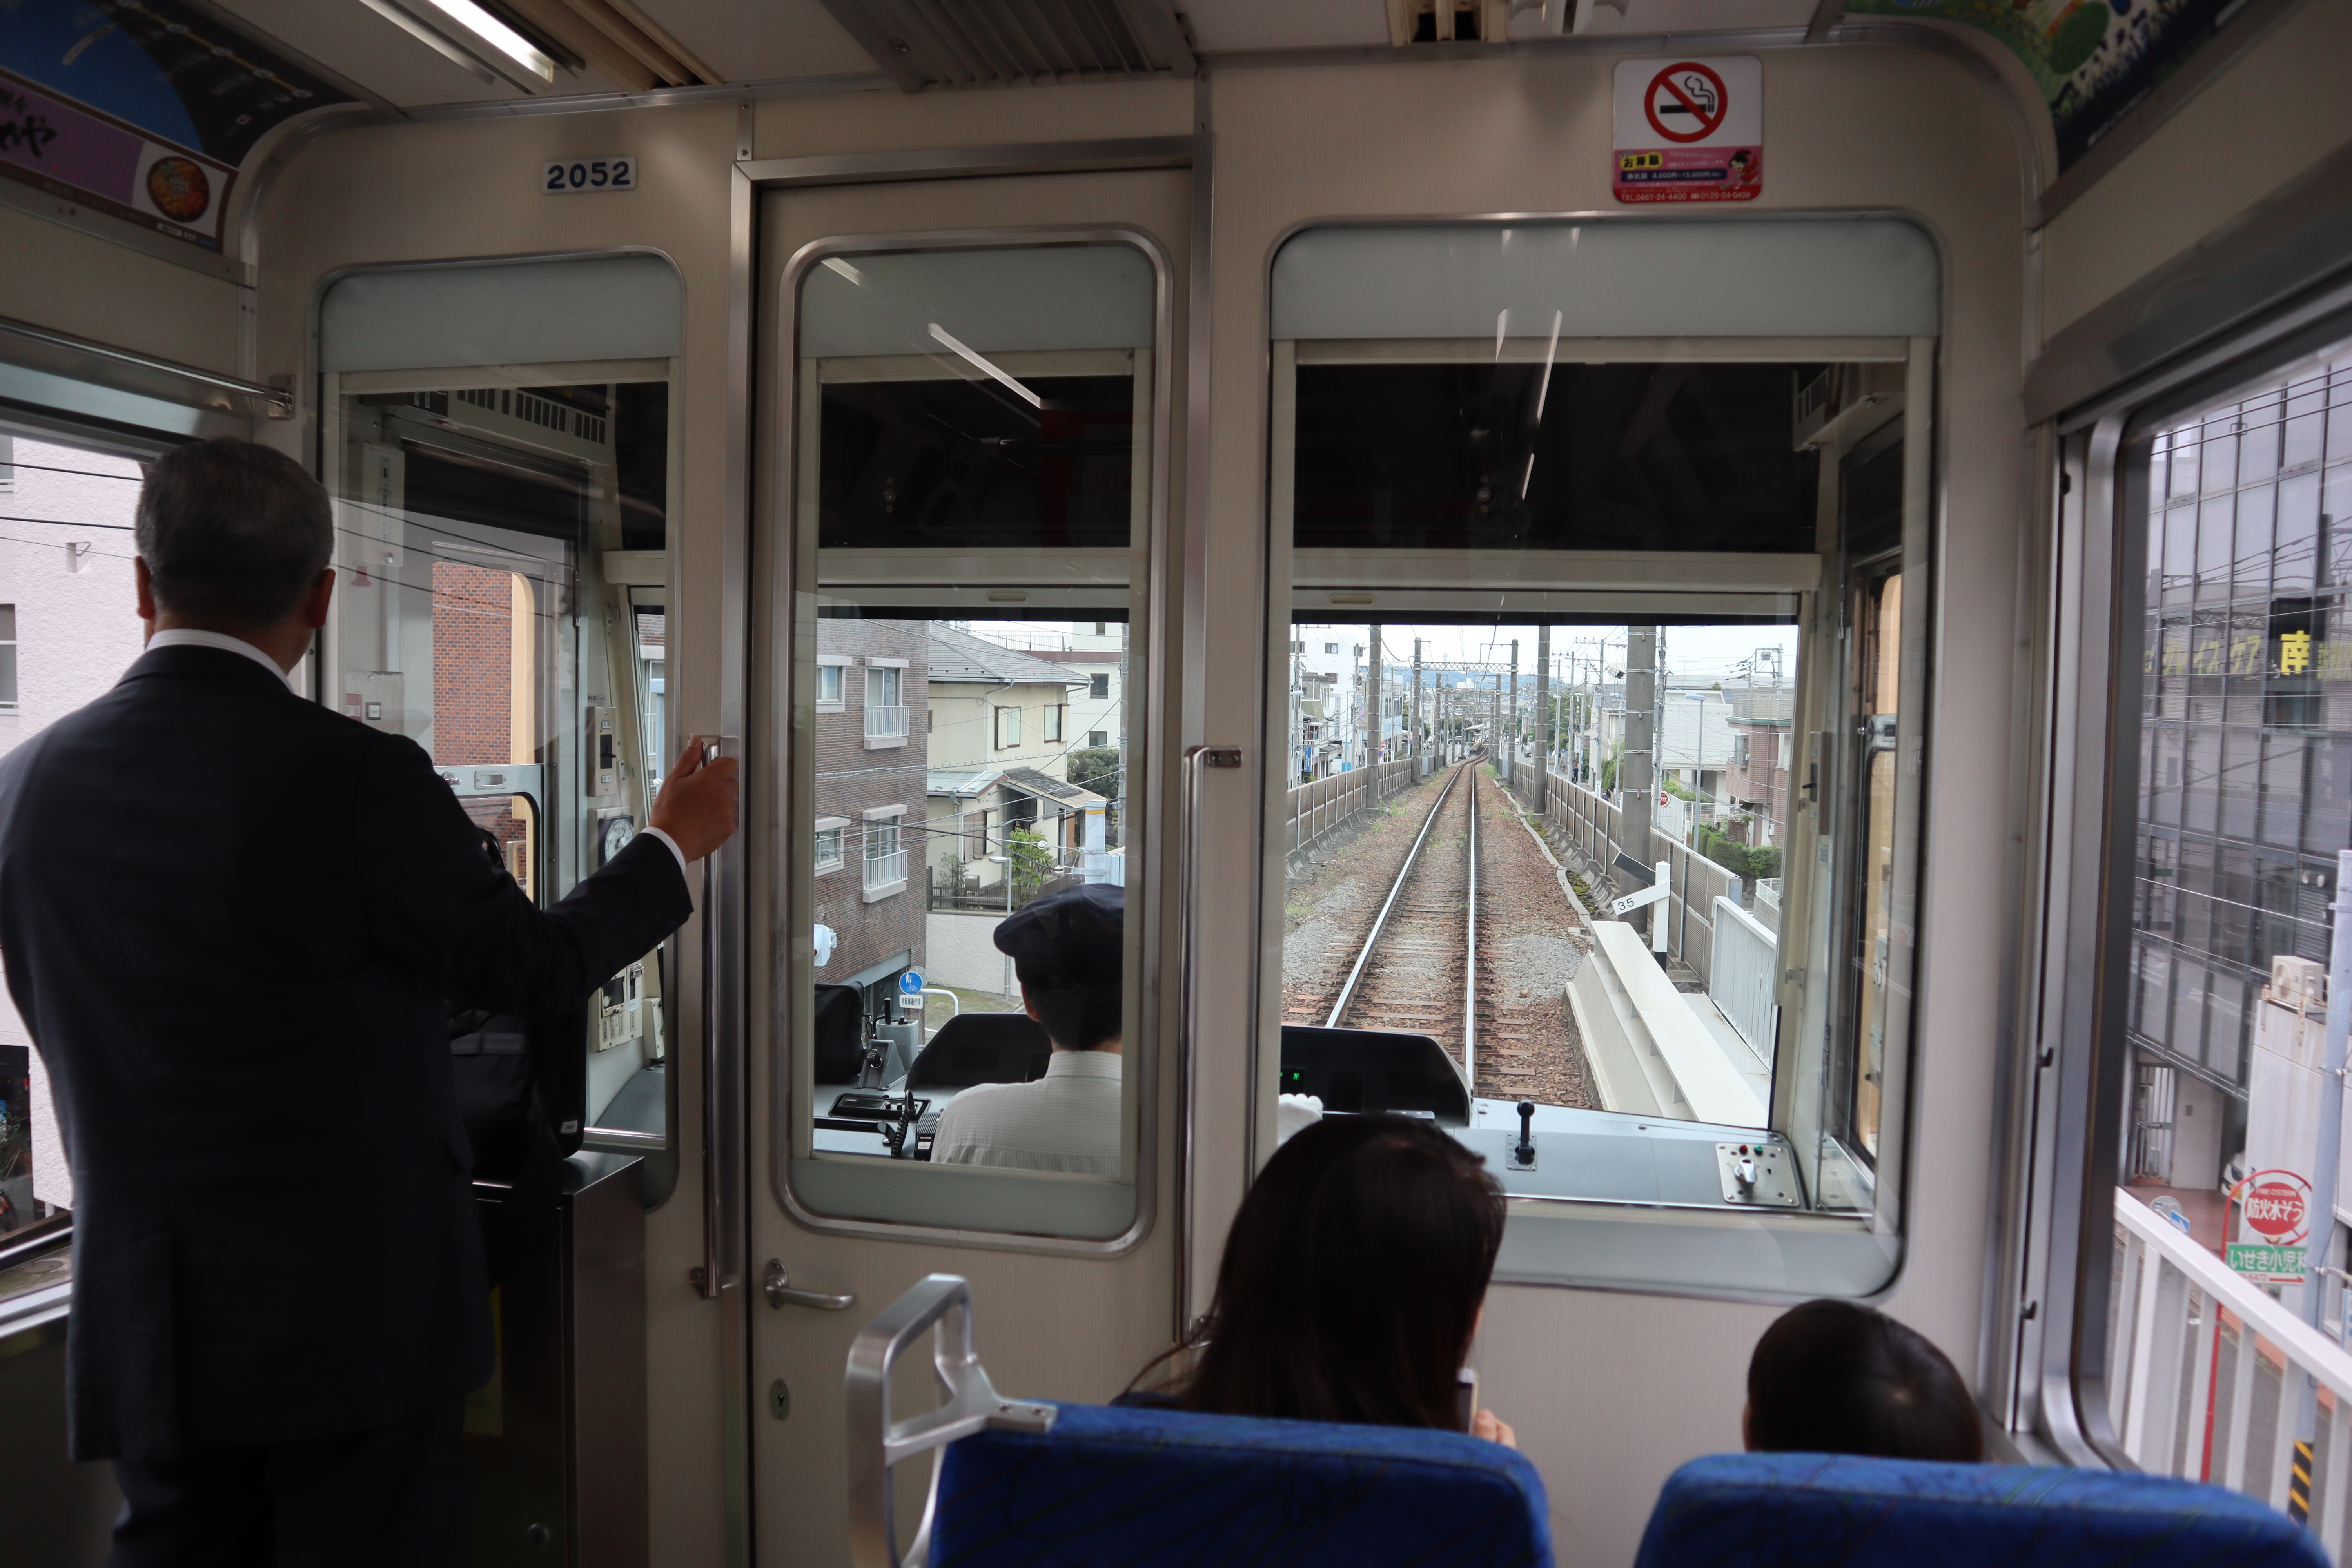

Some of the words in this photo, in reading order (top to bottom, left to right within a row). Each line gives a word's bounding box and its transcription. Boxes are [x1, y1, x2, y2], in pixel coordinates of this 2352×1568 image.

[546, 161, 630, 189] 2052
[1617, 898, 1635, 911] 35
[901, 998, 921, 1006] 自転車通行可
[2246, 1198, 2303, 1222] 防火水そう
